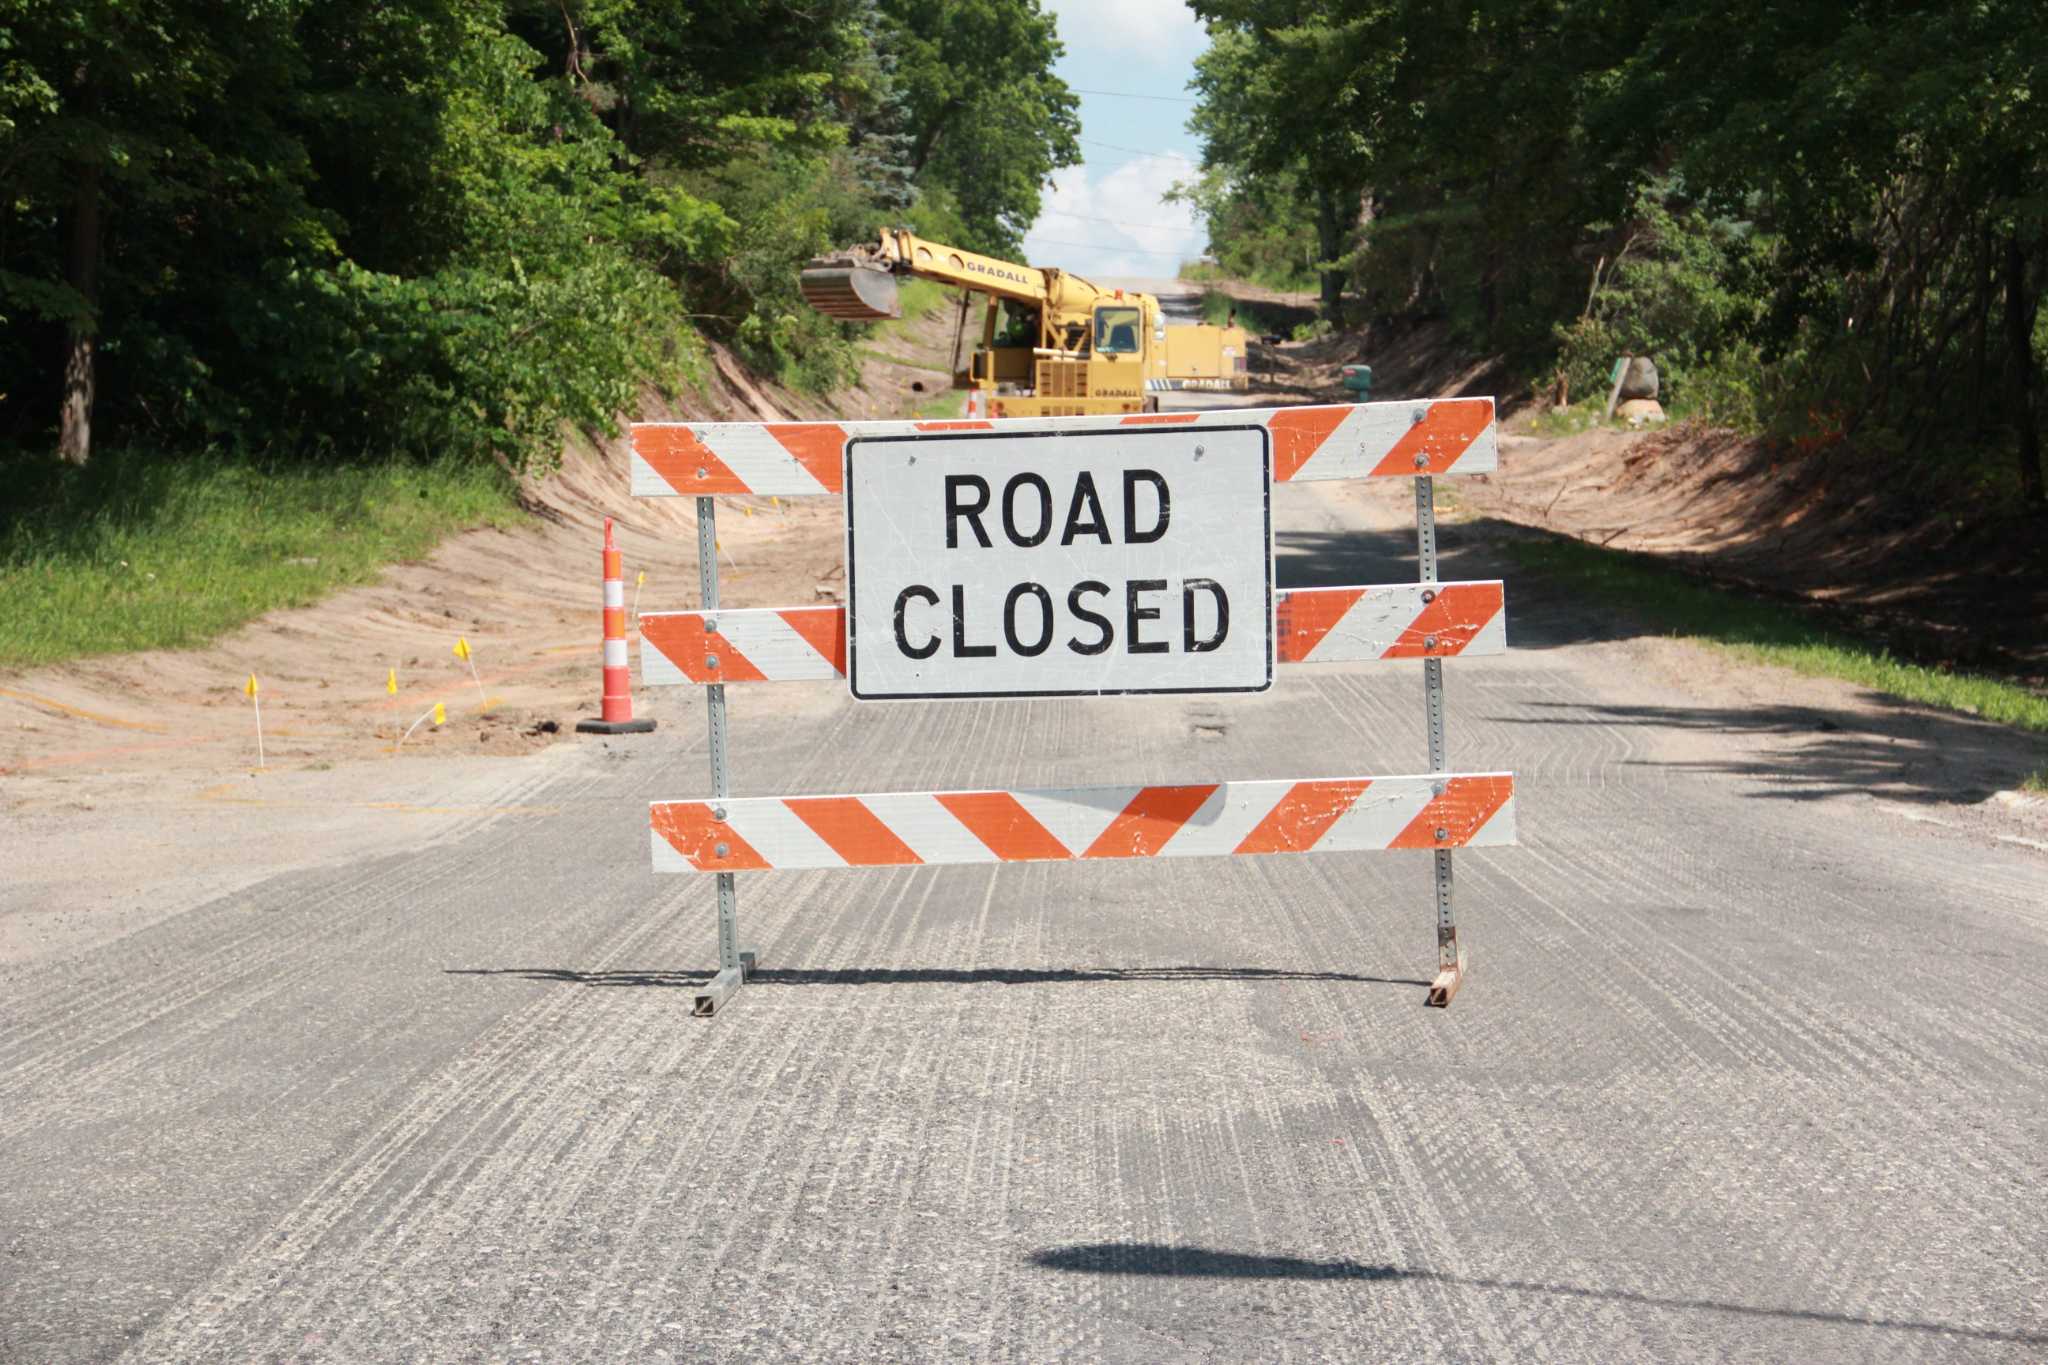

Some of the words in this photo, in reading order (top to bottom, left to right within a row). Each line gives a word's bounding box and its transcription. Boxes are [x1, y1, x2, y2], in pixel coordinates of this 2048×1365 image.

[967, 262, 1028, 283] GRADALL
[1095, 390, 1138, 398] GRADALL
[1182, 379, 1232, 390] GRADALL
[944, 469, 1171, 549] ROAD
[893, 578, 1230, 660] CLOSED
